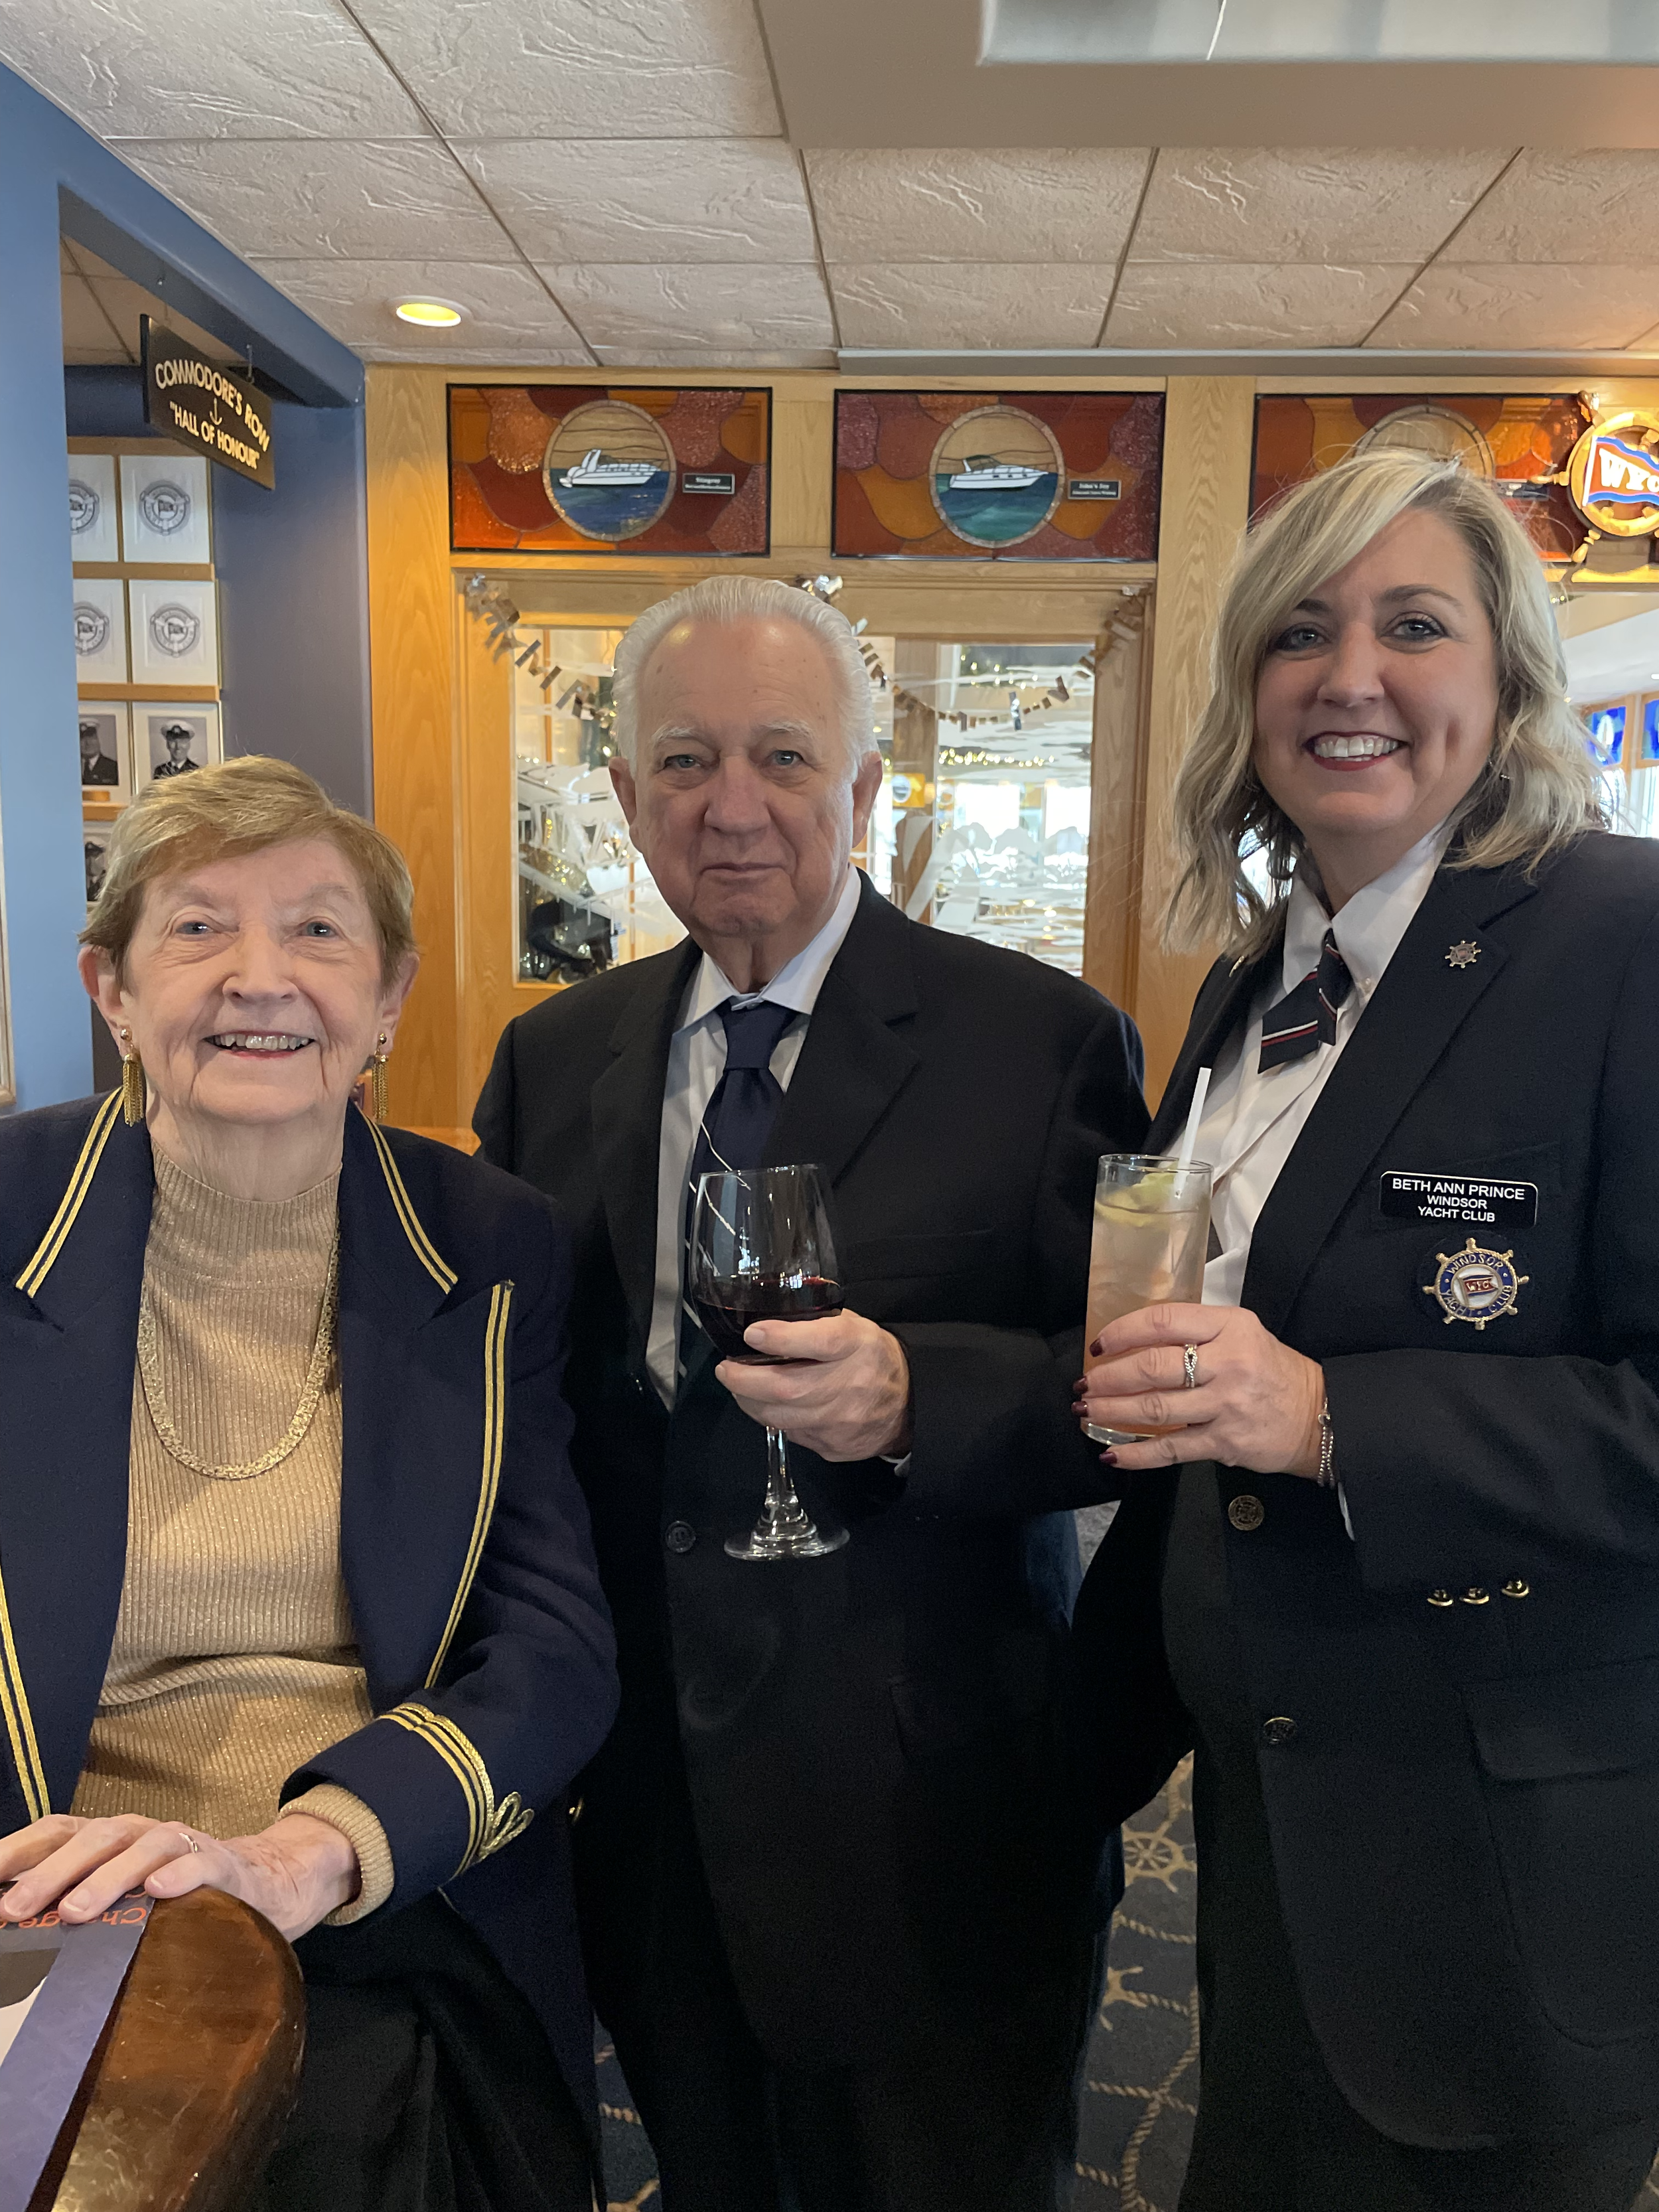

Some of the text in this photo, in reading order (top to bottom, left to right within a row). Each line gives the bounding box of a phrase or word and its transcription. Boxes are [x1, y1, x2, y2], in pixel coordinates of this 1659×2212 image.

[155, 359, 270, 452] COMMODORE'S ROW
[201, 421, 215, 445] OF
[1392, 1178, 1525, 1200] BETH ANN PRINCE
[1427, 1195, 1488, 1210] WINDSOR
[1418, 1206, 1496, 1222] YACHT CLUB
[1447, 1254, 1503, 1274] WINDSOR
[1441, 1285, 1513, 1317] YACHT CLUB
